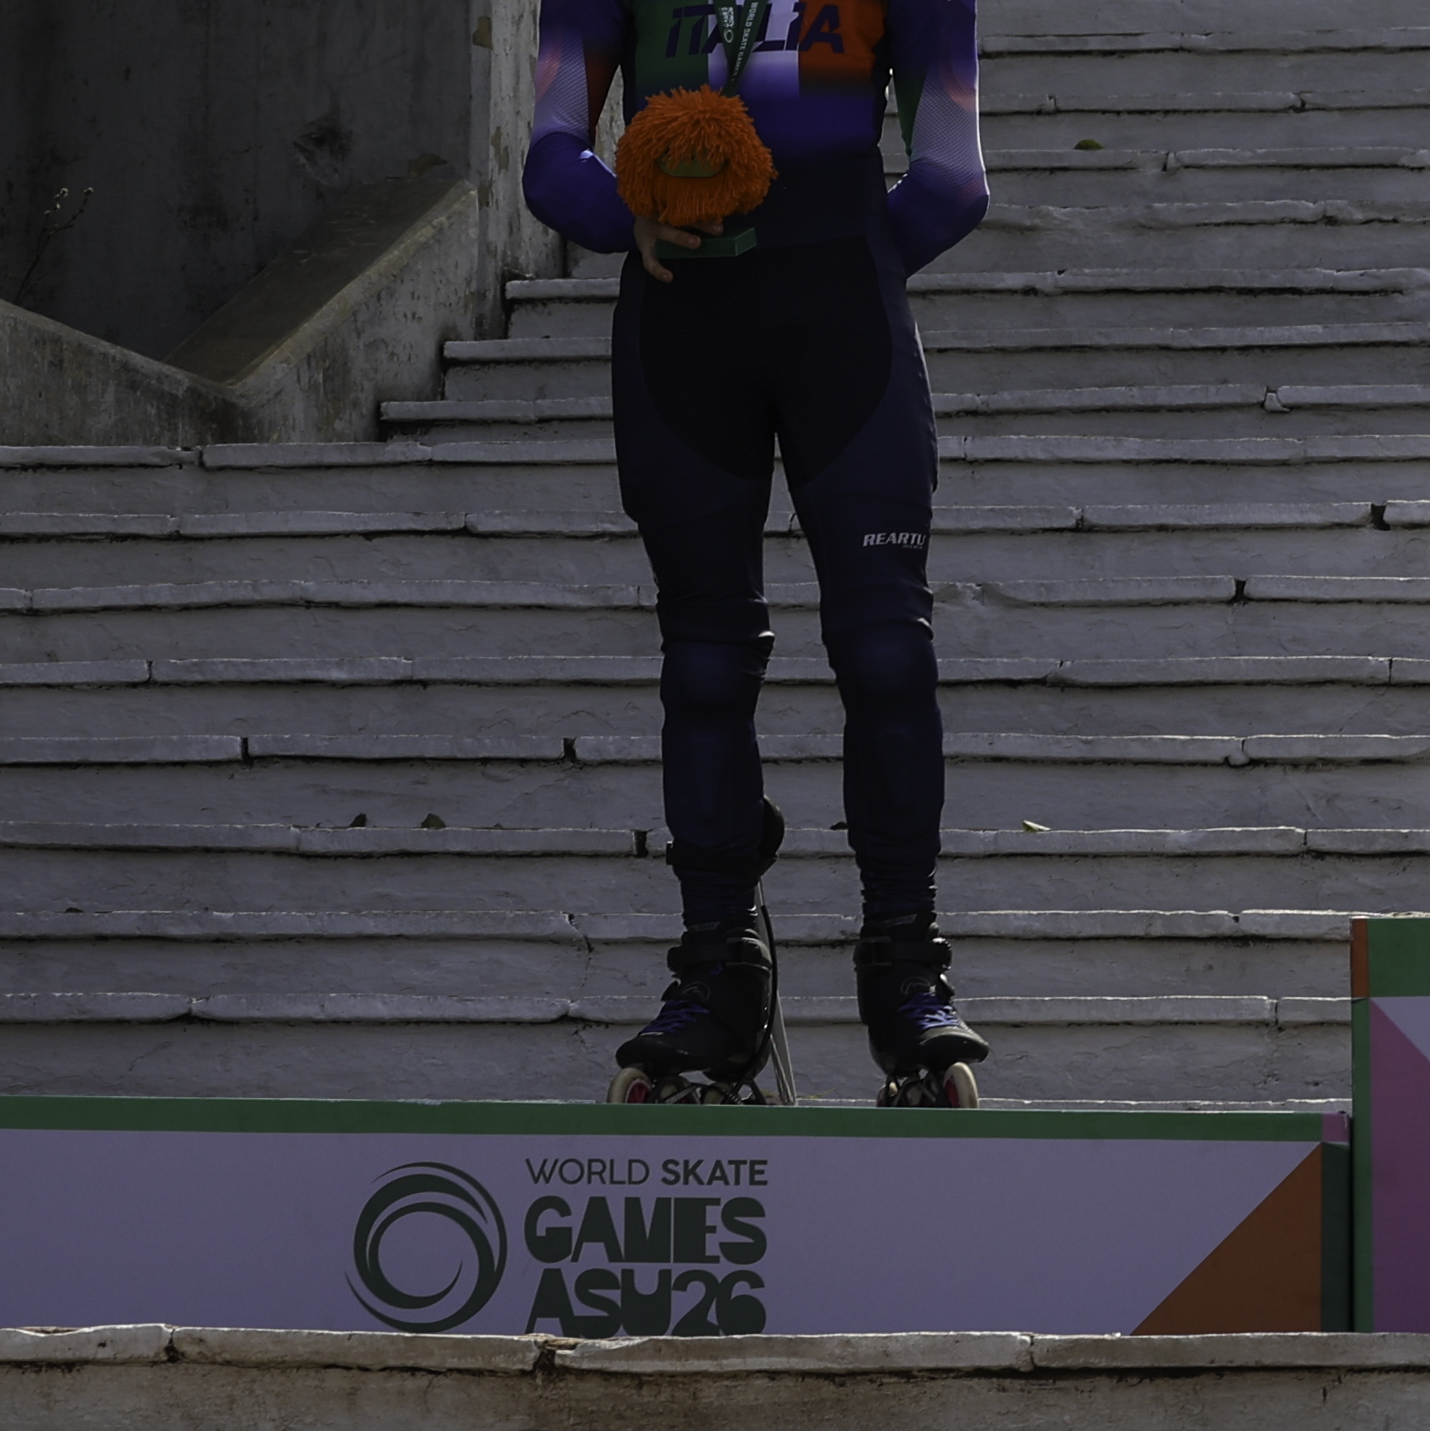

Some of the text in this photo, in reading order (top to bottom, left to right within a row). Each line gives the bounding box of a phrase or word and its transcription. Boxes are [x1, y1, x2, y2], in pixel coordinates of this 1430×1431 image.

[745, 1, 759, 27] WORLD
[862, 532, 927, 548] REARTU
[525, 1158, 768, 1186] WORLD SKATE
[524, 1196, 767, 1265] GAMES
[525, 1268, 767, 1338] ASU26
